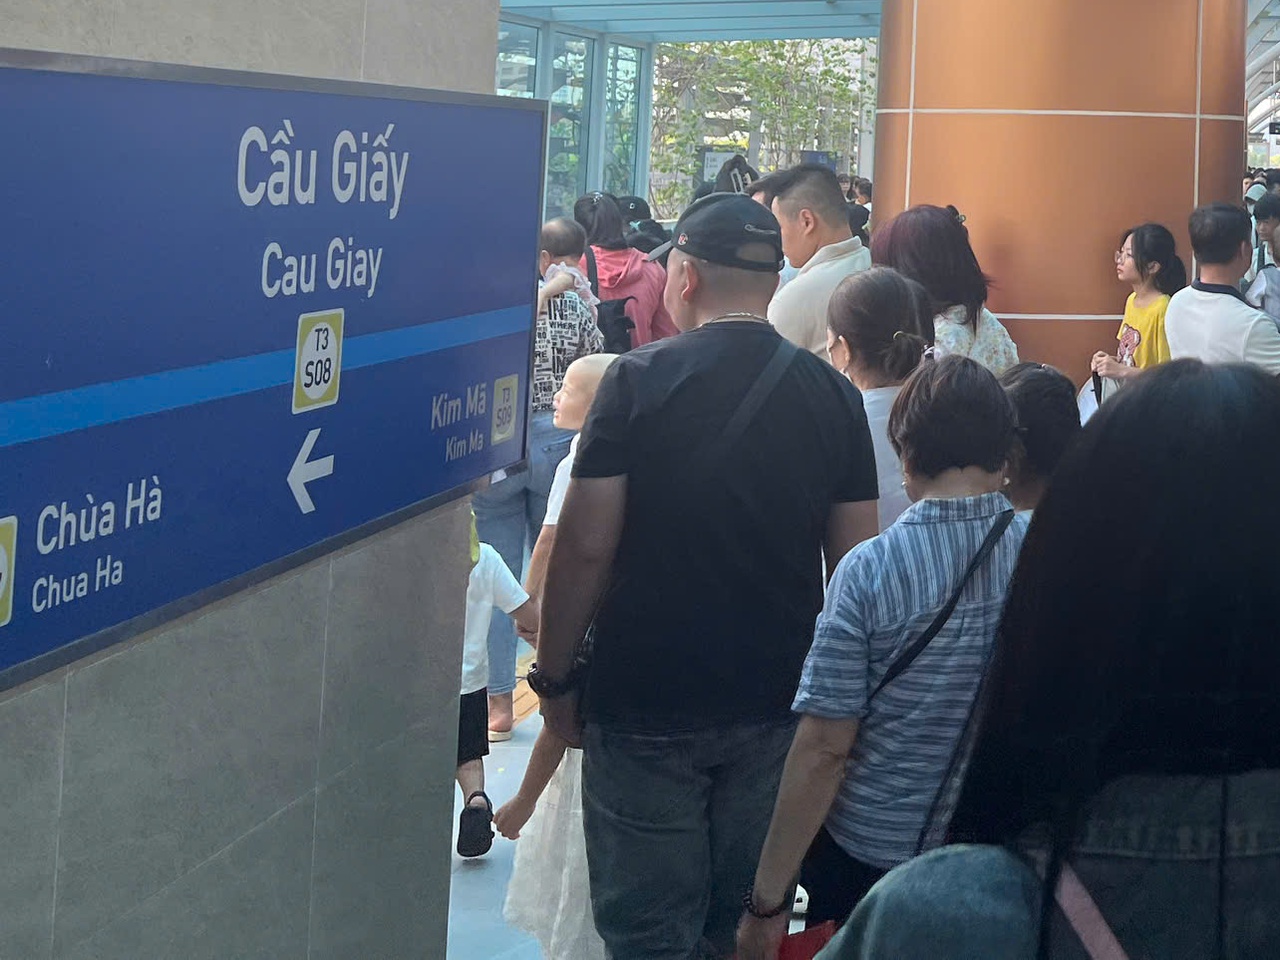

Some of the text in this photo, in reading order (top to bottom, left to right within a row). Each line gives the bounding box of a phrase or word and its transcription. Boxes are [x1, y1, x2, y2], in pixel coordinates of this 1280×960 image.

[238, 119, 409, 220] Cầu Giấy
[261, 237, 383, 298] Cau Giay
[315, 327, 329, 351] T3
[303, 357, 332, 388] S08
[431, 382, 487, 430] Kim Mã
[502, 387, 511, 404] T3
[495, 405, 512, 428] S09
[445, 428, 484, 462] Kim Ma
[36, 475, 162, 555] Chùa Hà
[32, 554, 123, 613] Chua Ha
